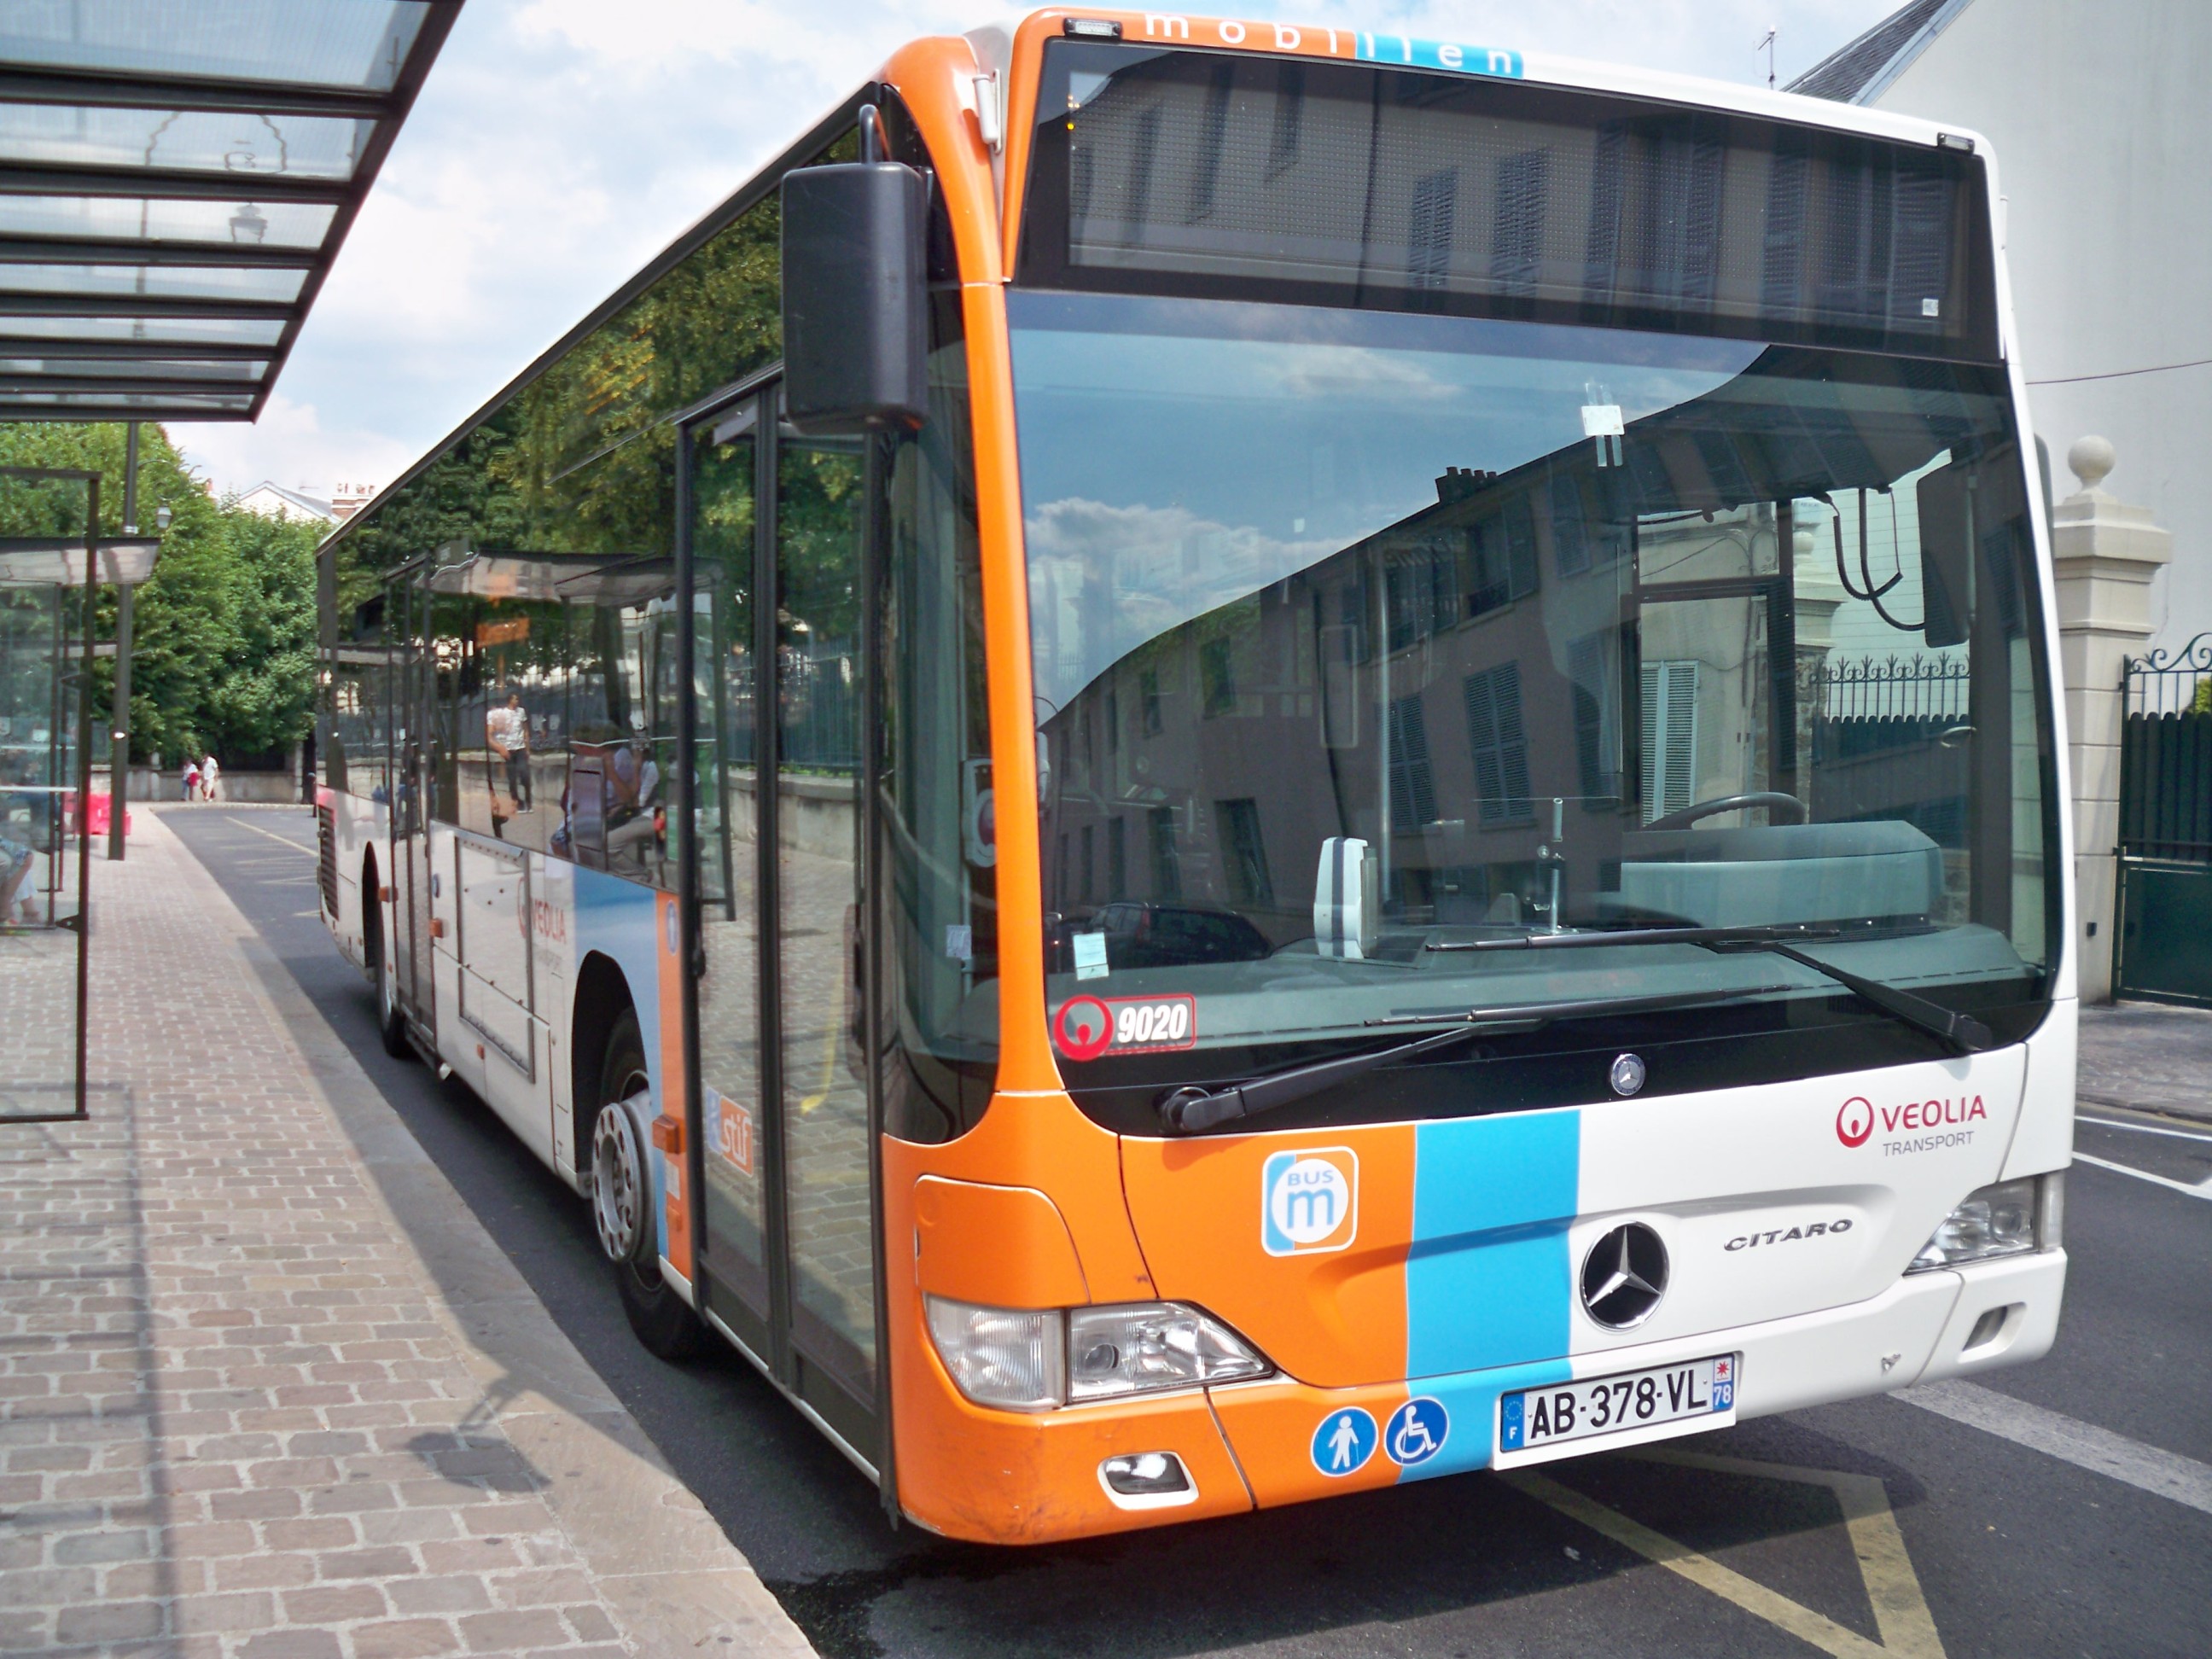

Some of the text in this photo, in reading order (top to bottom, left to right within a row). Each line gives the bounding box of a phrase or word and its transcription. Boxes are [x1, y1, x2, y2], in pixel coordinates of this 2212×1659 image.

[1144, 13, 1511, 74] mobilien
[1117, 1004, 1188, 1043] 9020
[1880, 1095, 1988, 1132] VEOLIA
[719, 1113, 753, 1166] stif
[1883, 1131, 1975, 1156] TRANSPORT
[1287, 1170, 1334, 1186] BUS
[1287, 1188, 1335, 1229] m
[1723, 1219, 1853, 1251] CITARO
[1509, 1426, 1517, 1440] F
[1714, 1384, 1732, 1406] 78
